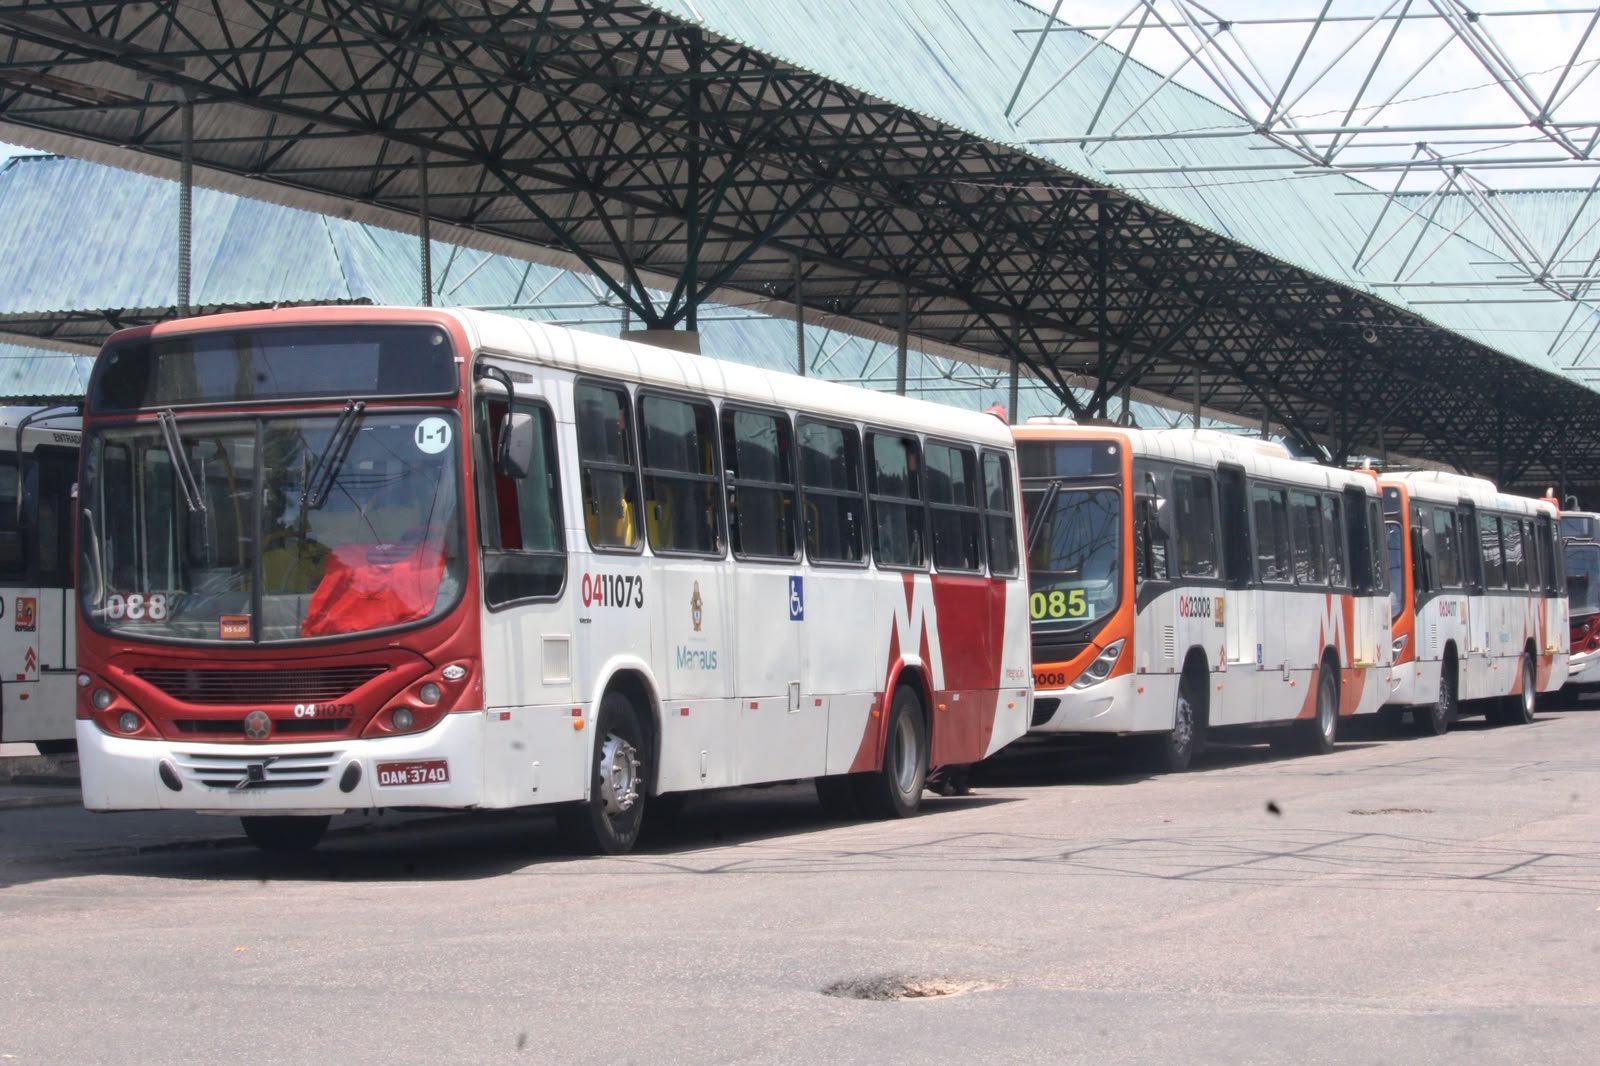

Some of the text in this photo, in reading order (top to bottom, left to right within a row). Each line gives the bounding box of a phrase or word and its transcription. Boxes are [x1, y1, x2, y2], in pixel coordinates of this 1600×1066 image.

[418, 425, 447, 444] I-1
[581, 572, 644, 609] 0411073
[107, 594, 167, 620] 088
[1030, 589, 1086, 619] 085
[1180, 596, 1211, 618] 0623008
[676, 645, 718, 671] Manaus
[294, 703, 356, 717] 0411073
